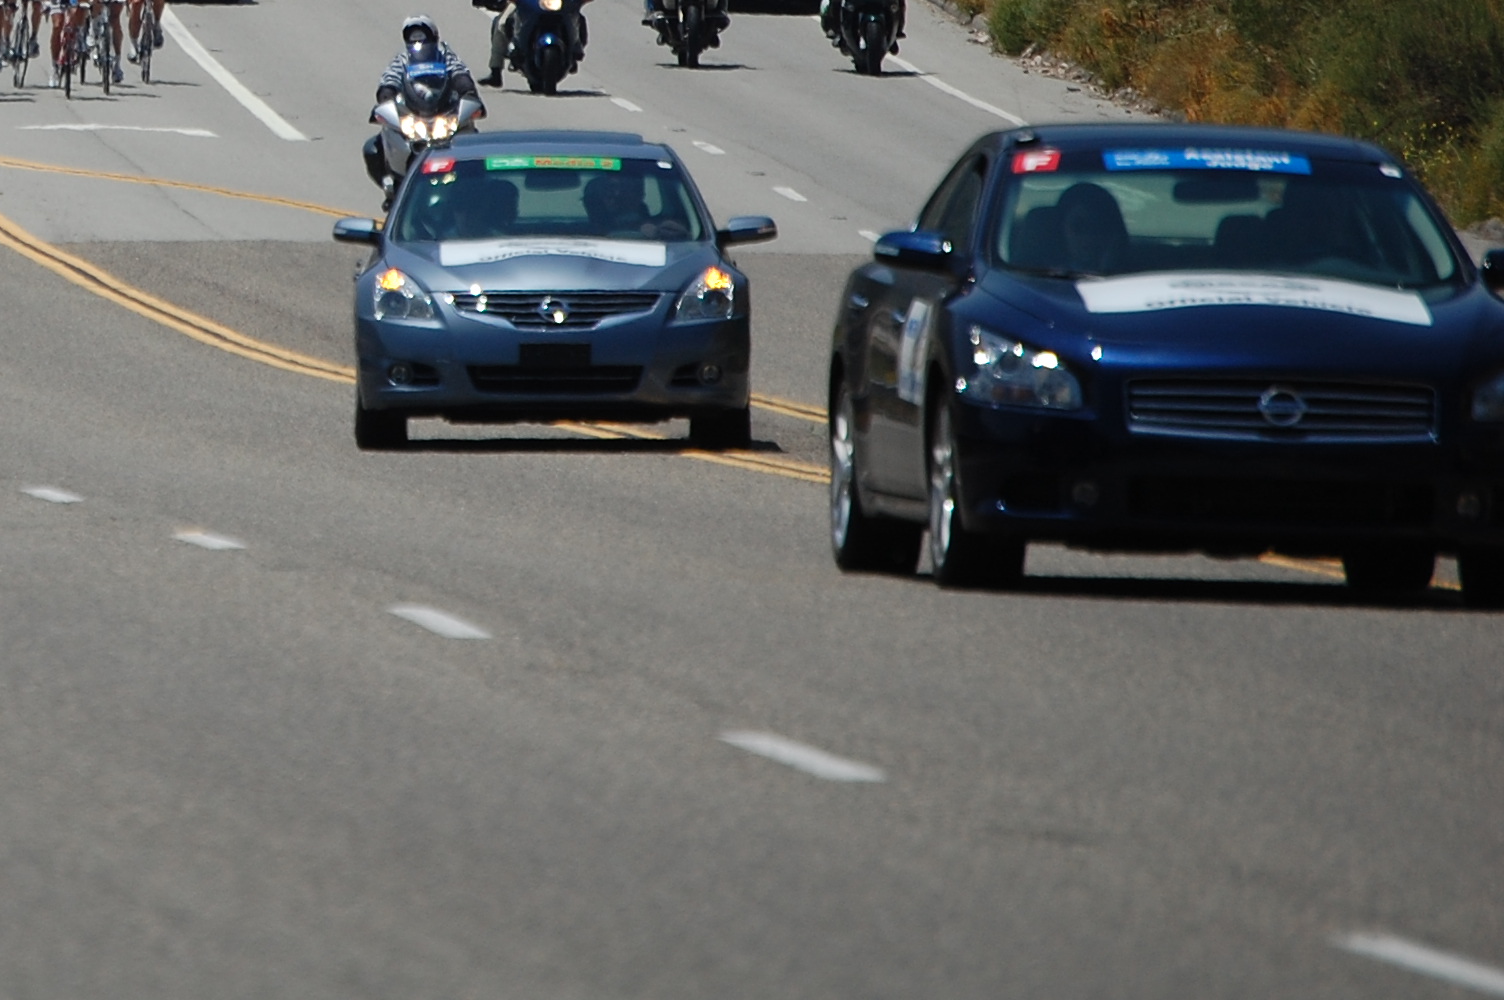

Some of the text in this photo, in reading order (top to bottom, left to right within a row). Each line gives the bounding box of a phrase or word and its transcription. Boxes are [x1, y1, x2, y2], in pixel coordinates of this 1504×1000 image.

[534, 158, 595, 168] Media
[1022, 152, 1054, 171] F
[480, 248, 628, 263] Official Vehicle
